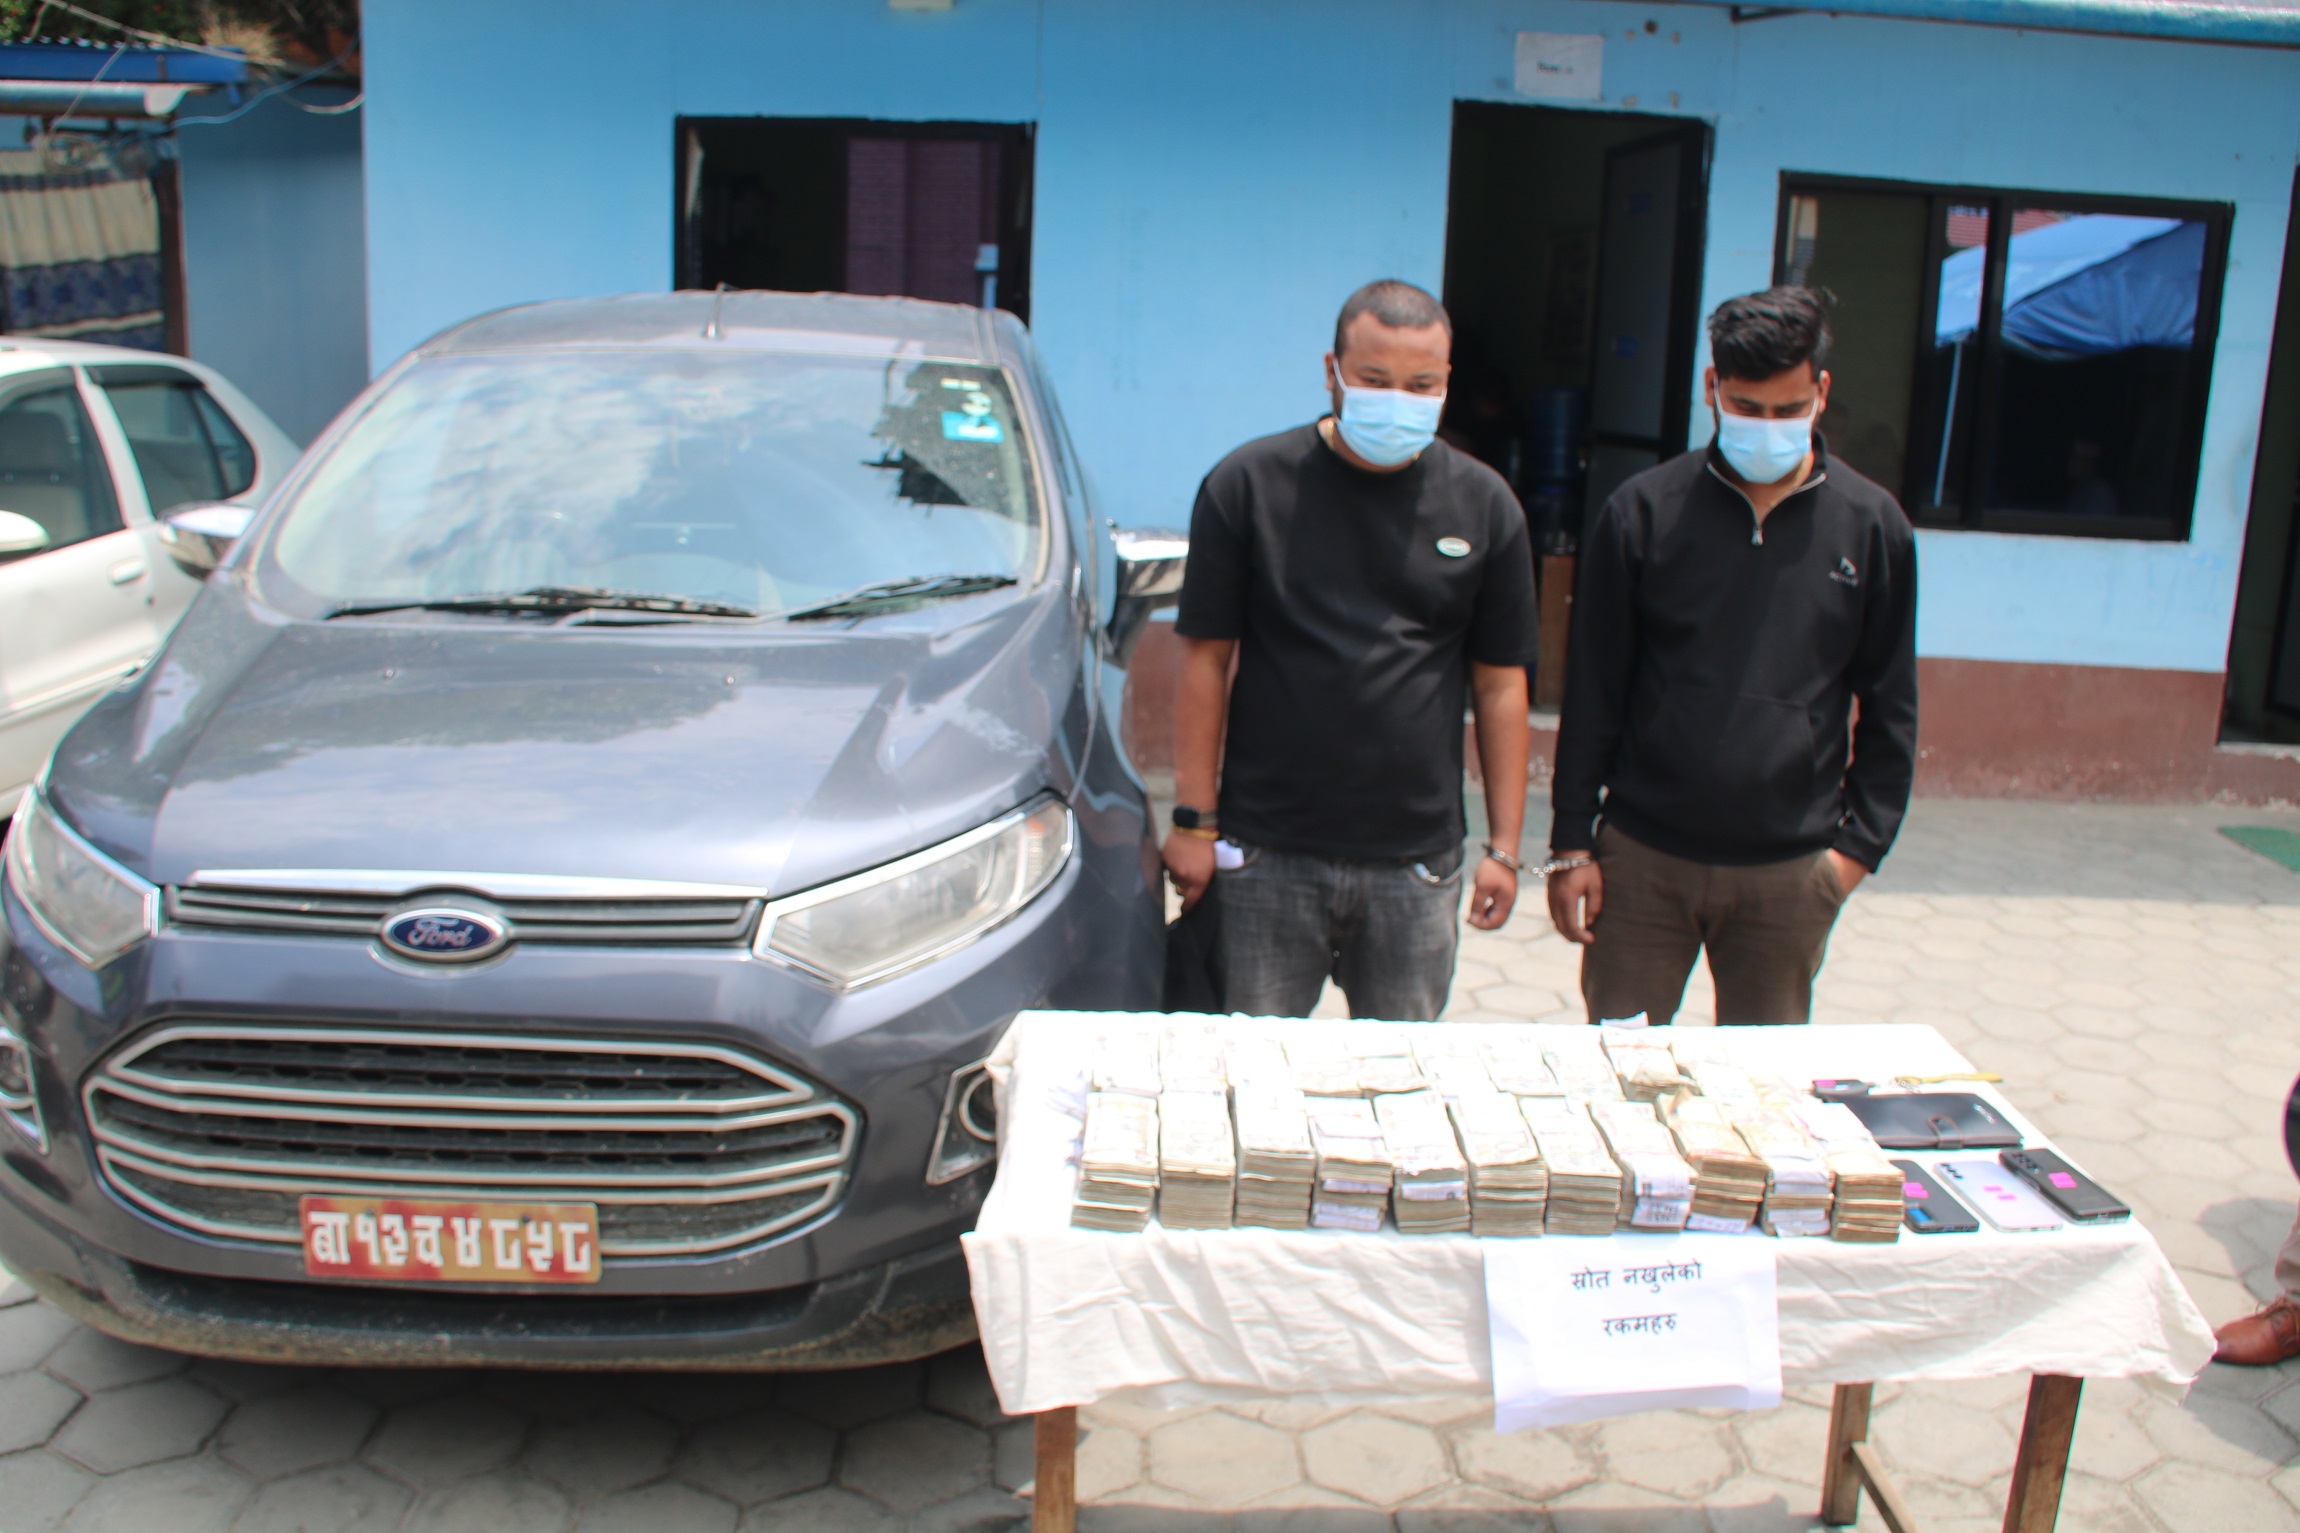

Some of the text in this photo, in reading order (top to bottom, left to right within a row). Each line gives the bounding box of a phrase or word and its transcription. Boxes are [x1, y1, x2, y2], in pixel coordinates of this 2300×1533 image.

[407, 917, 474, 947] Ford
[1622, 1257, 1703, 1293] नखुलेको
[1602, 1312, 1678, 1337] रकमहरु
